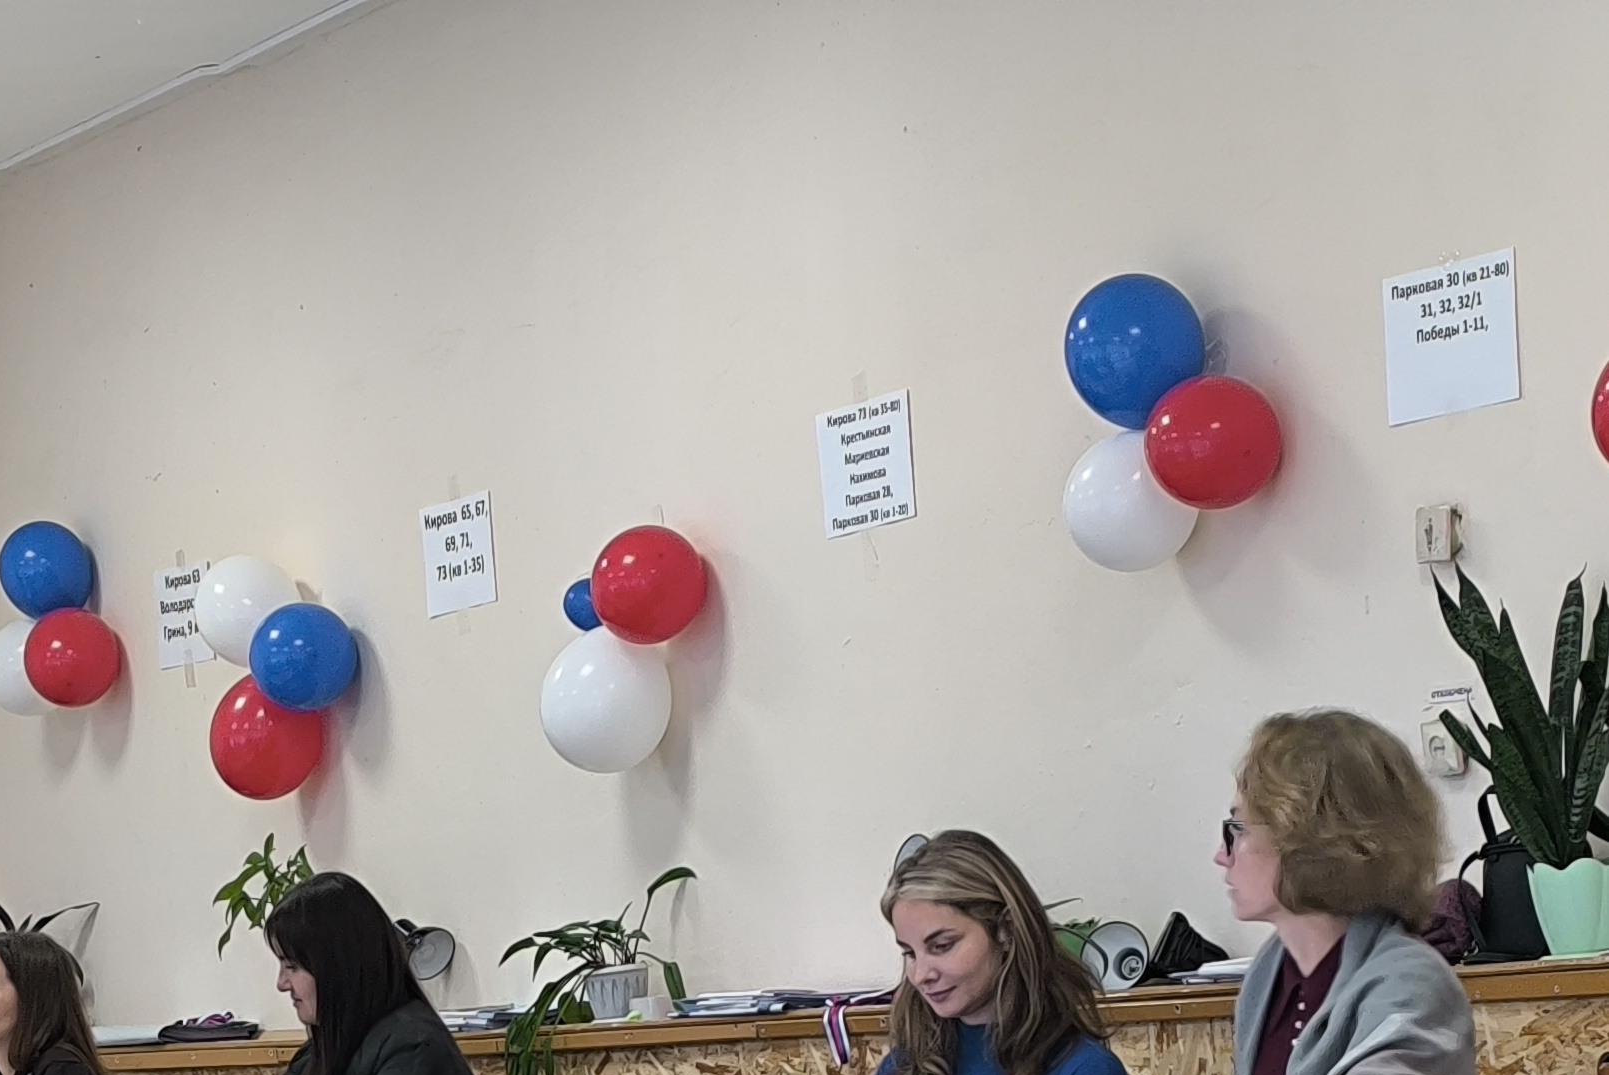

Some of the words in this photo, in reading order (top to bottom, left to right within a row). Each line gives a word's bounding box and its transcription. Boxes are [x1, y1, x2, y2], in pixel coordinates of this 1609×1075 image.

[1391, 278, 1444, 301] Парковая
[1446, 272, 1460, 288] 30
[1462, 270, 1478, 287] (кв
[1479, 259, 1510, 280] 21-80)
[1420, 302, 1437, 319] 31,
[1439, 298, 1456, 315] 32,
[1458, 290, 1483, 311] 32/1
[1416, 324, 1460, 344] Победы
[1463, 315, 1489, 332] 1-11,
[827, 411, 856, 429] Кирова
[424, 511, 458, 531] Кирова
[461, 504, 474, 521] 65,
[475, 500, 488, 518] 67,
[445, 535, 459, 553] 69,
[460, 531, 473, 550] 71,
[436, 564, 447, 582] 73
[449, 561, 462, 582] (кв
[463, 553, 485, 575] 1-35)
